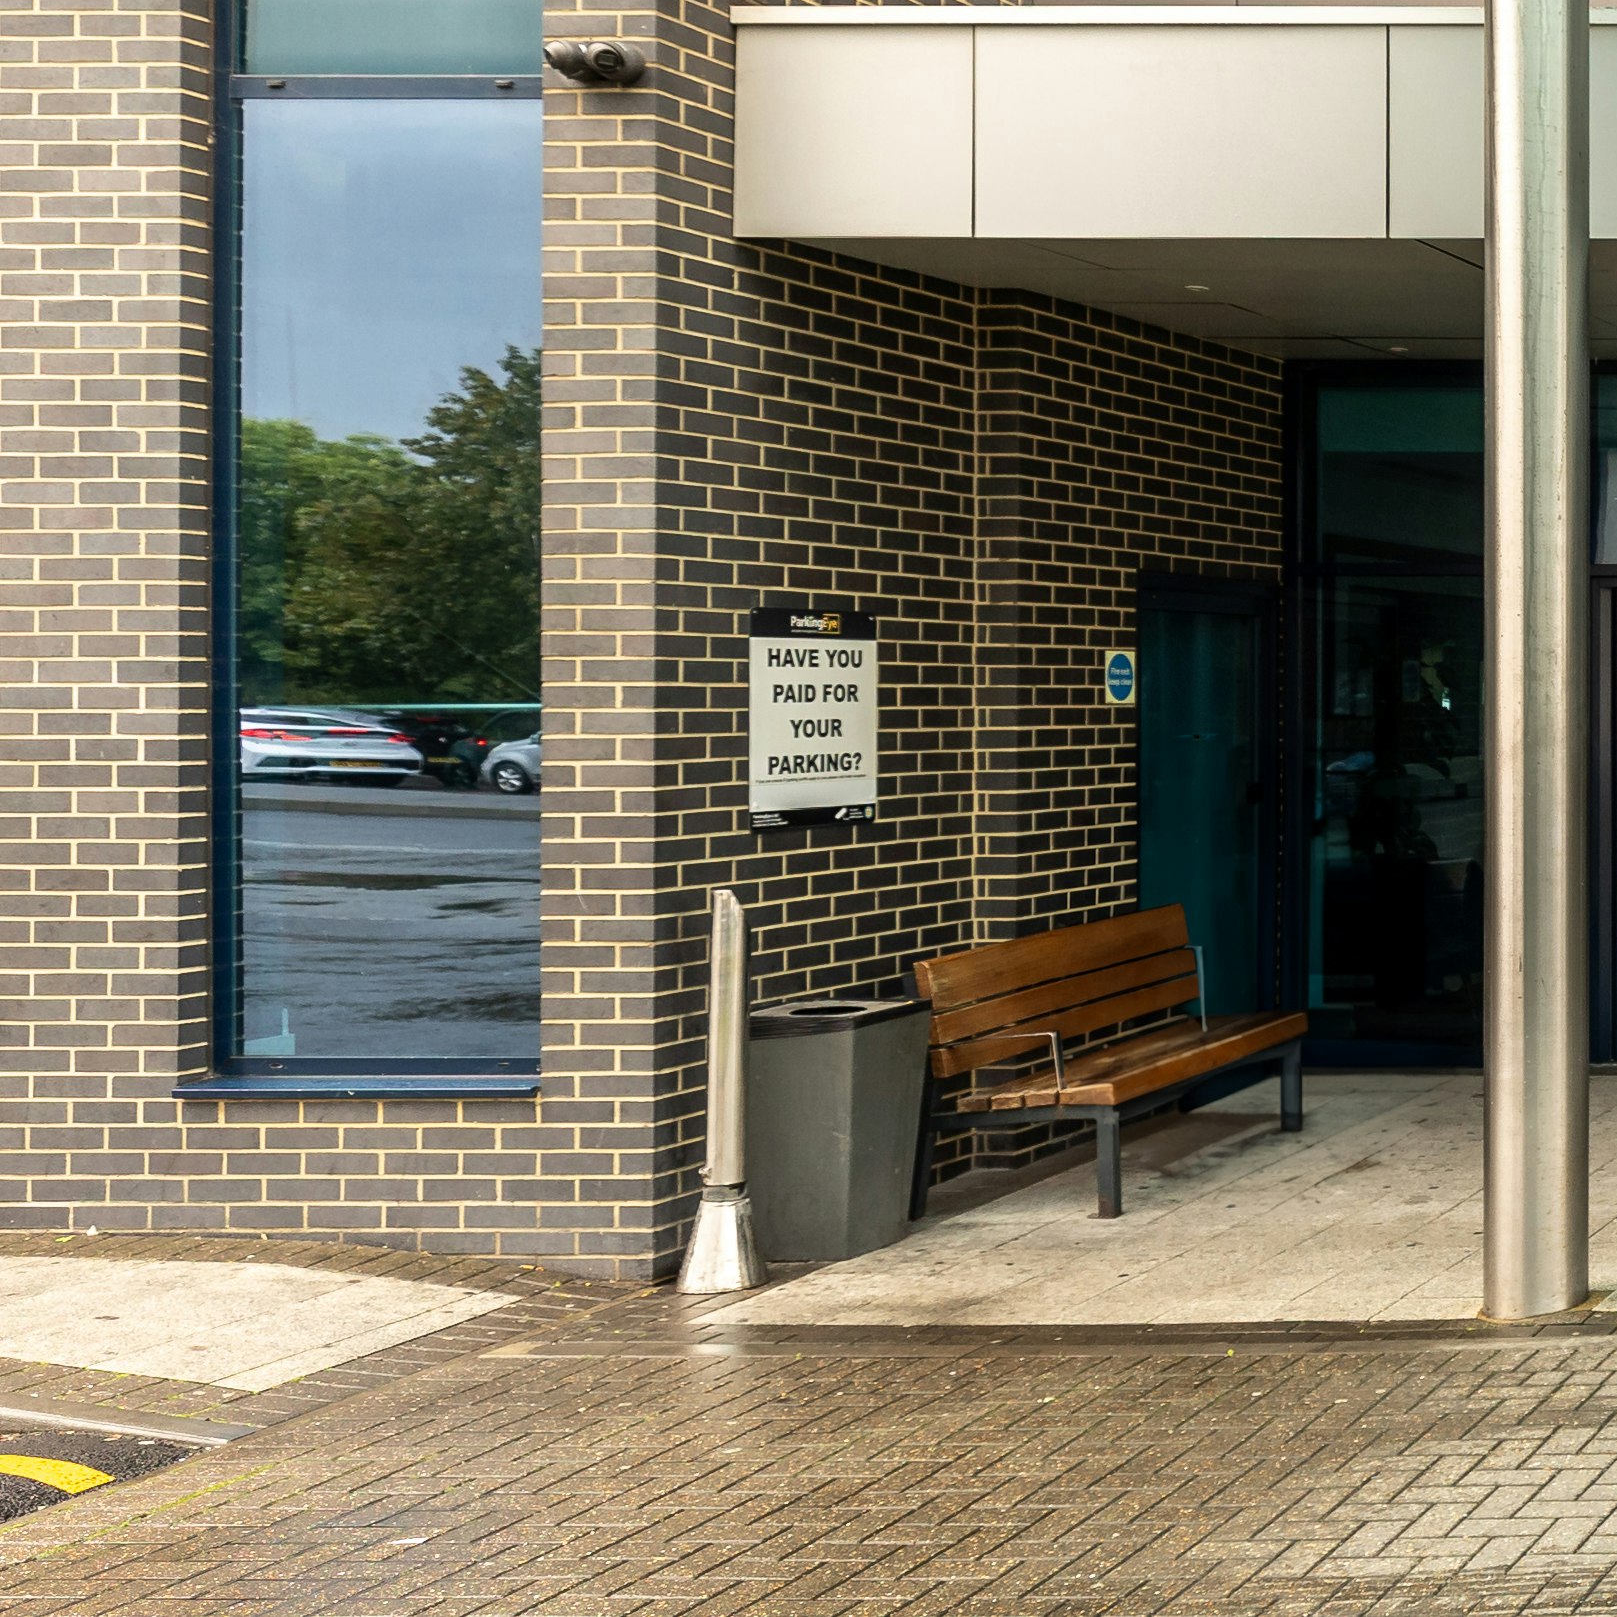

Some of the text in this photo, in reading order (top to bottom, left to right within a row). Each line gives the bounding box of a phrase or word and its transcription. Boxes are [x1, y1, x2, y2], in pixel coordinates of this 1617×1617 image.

[790, 615, 838, 630] ParkingEye
[767, 648, 863, 668] HAVE YOU
[772, 684, 859, 703] PAID FOR
[790, 719, 842, 738] YOUR
[767, 752, 862, 775] PARKING?
